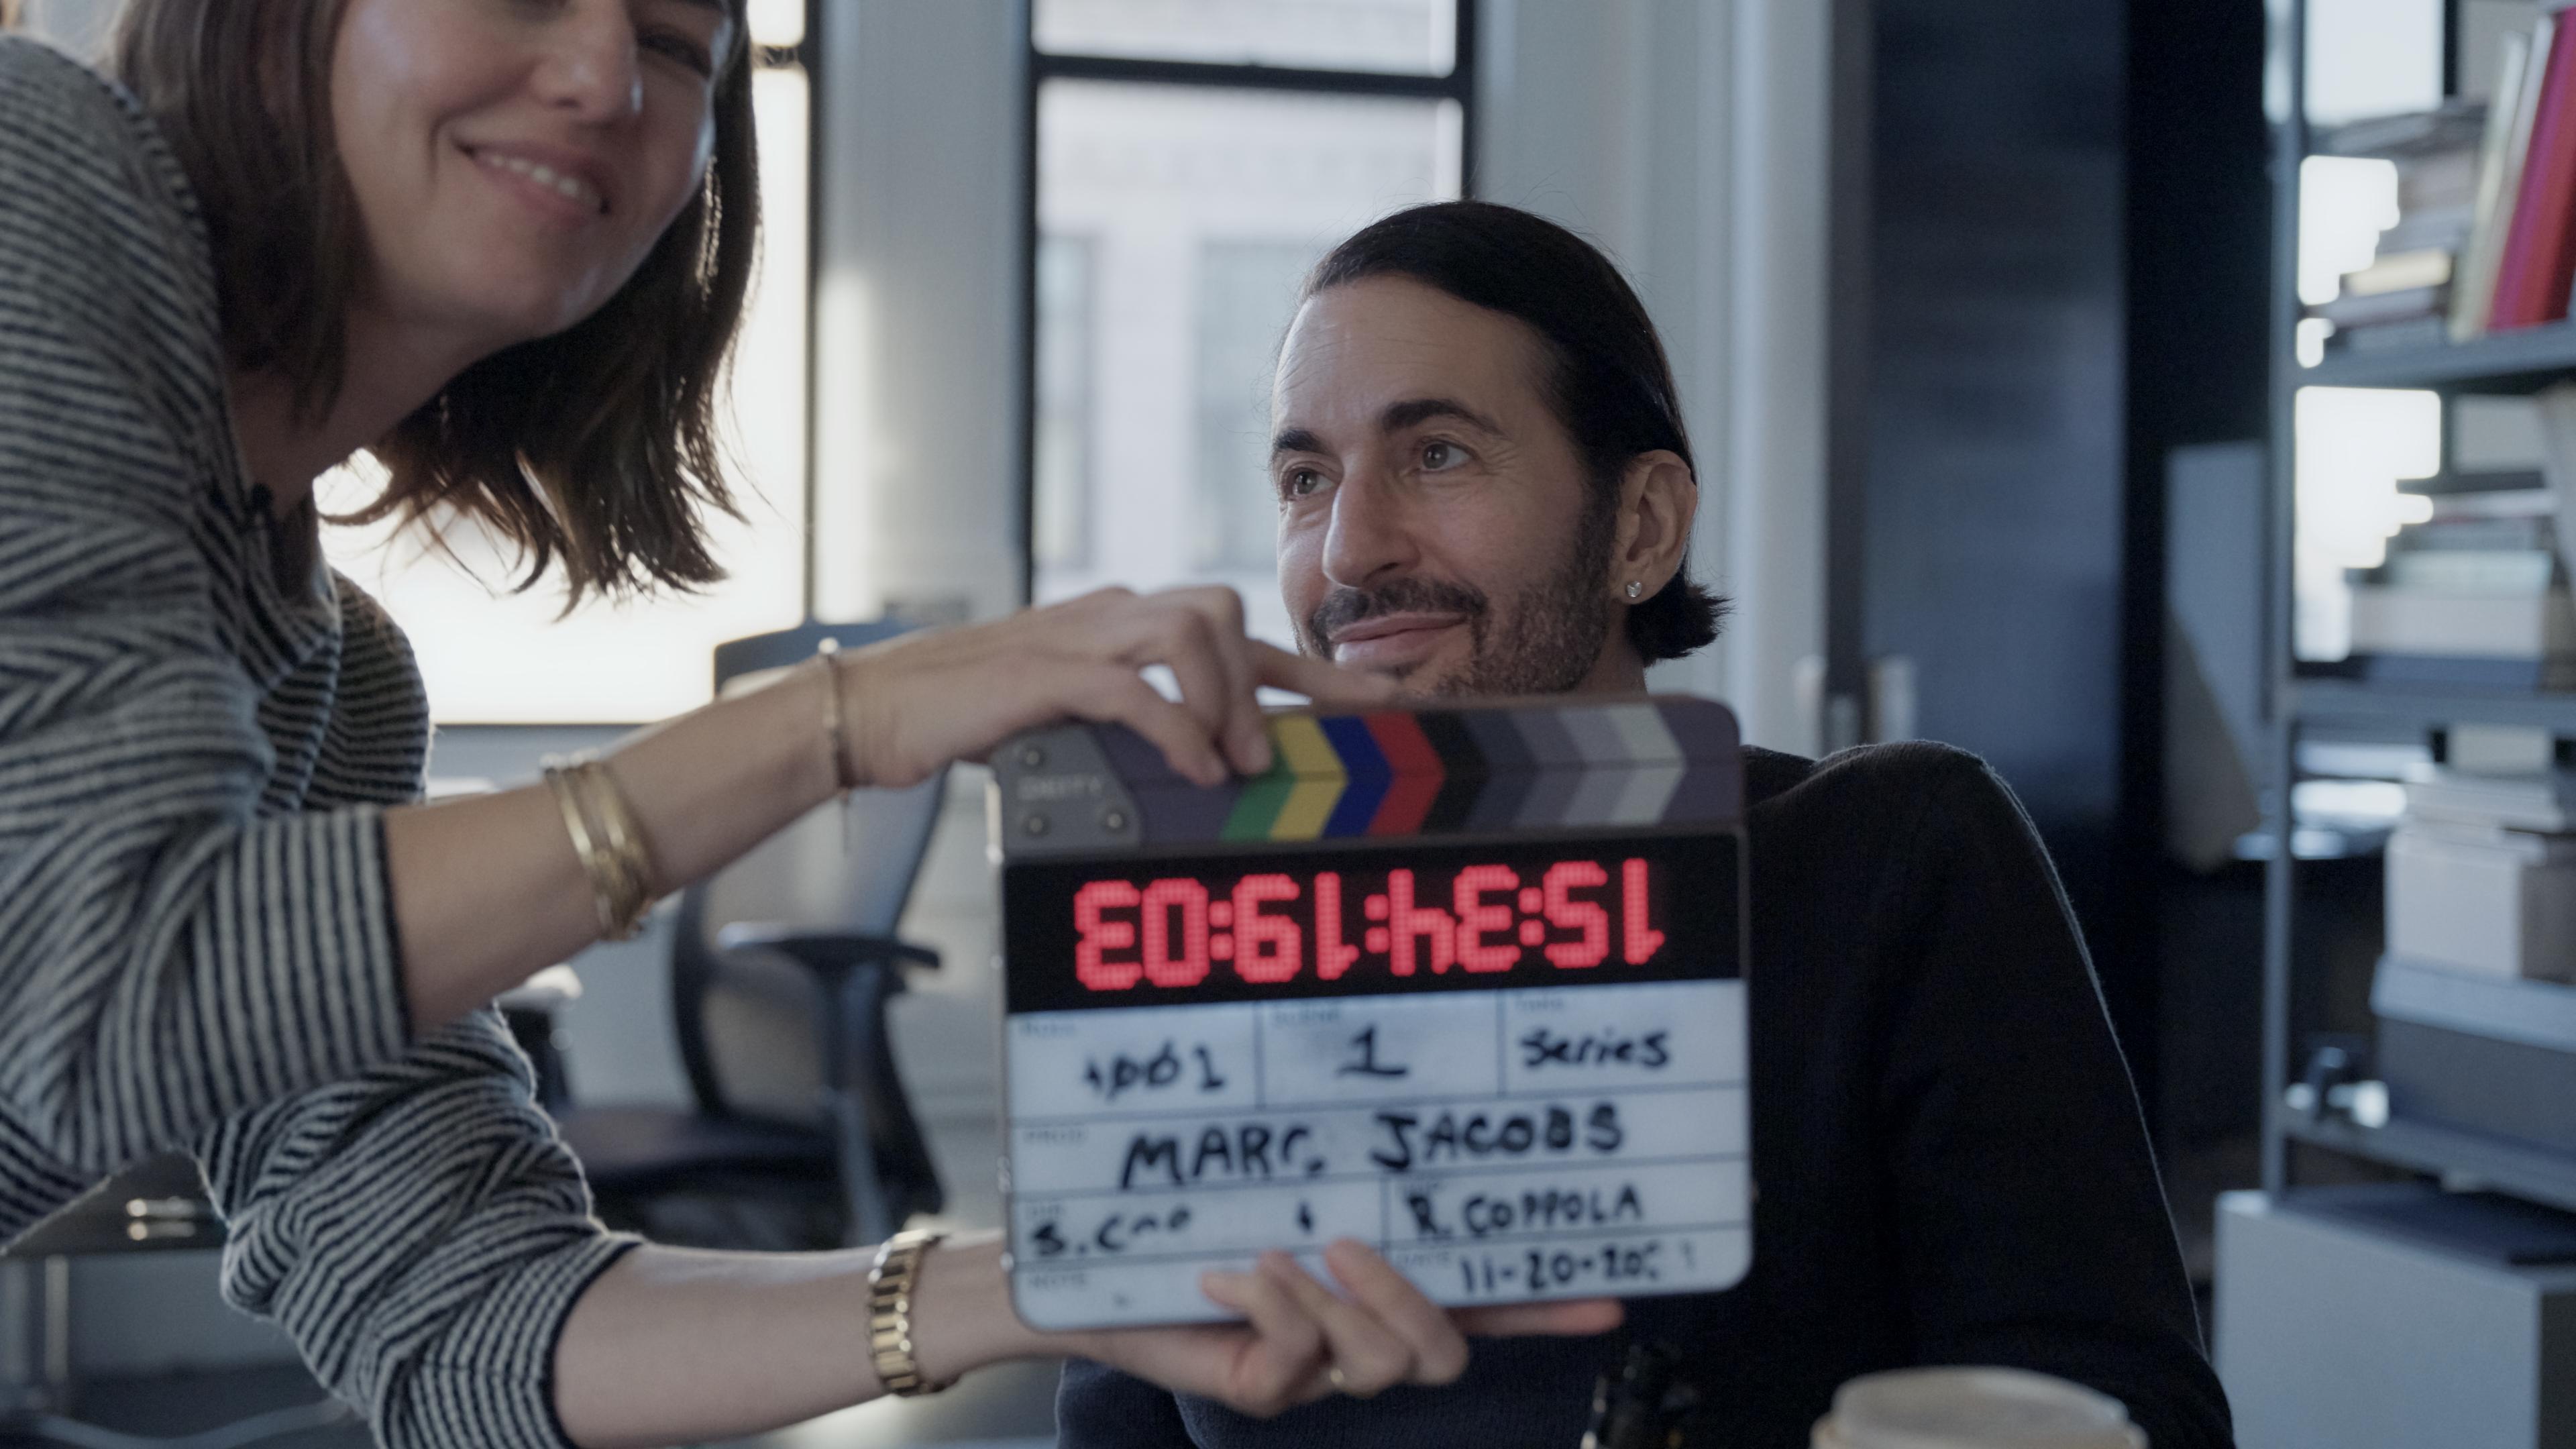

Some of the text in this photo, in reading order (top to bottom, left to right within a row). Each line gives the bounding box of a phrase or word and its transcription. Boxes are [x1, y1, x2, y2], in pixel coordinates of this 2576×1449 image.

[1073, 857, 1665, 991] 15:34:19:03
[1336, 1024, 1409, 1079] 1
[1369, 1102, 1623, 1171] JACOBS
[1463, 1183, 1642, 1237] COPPOLA
